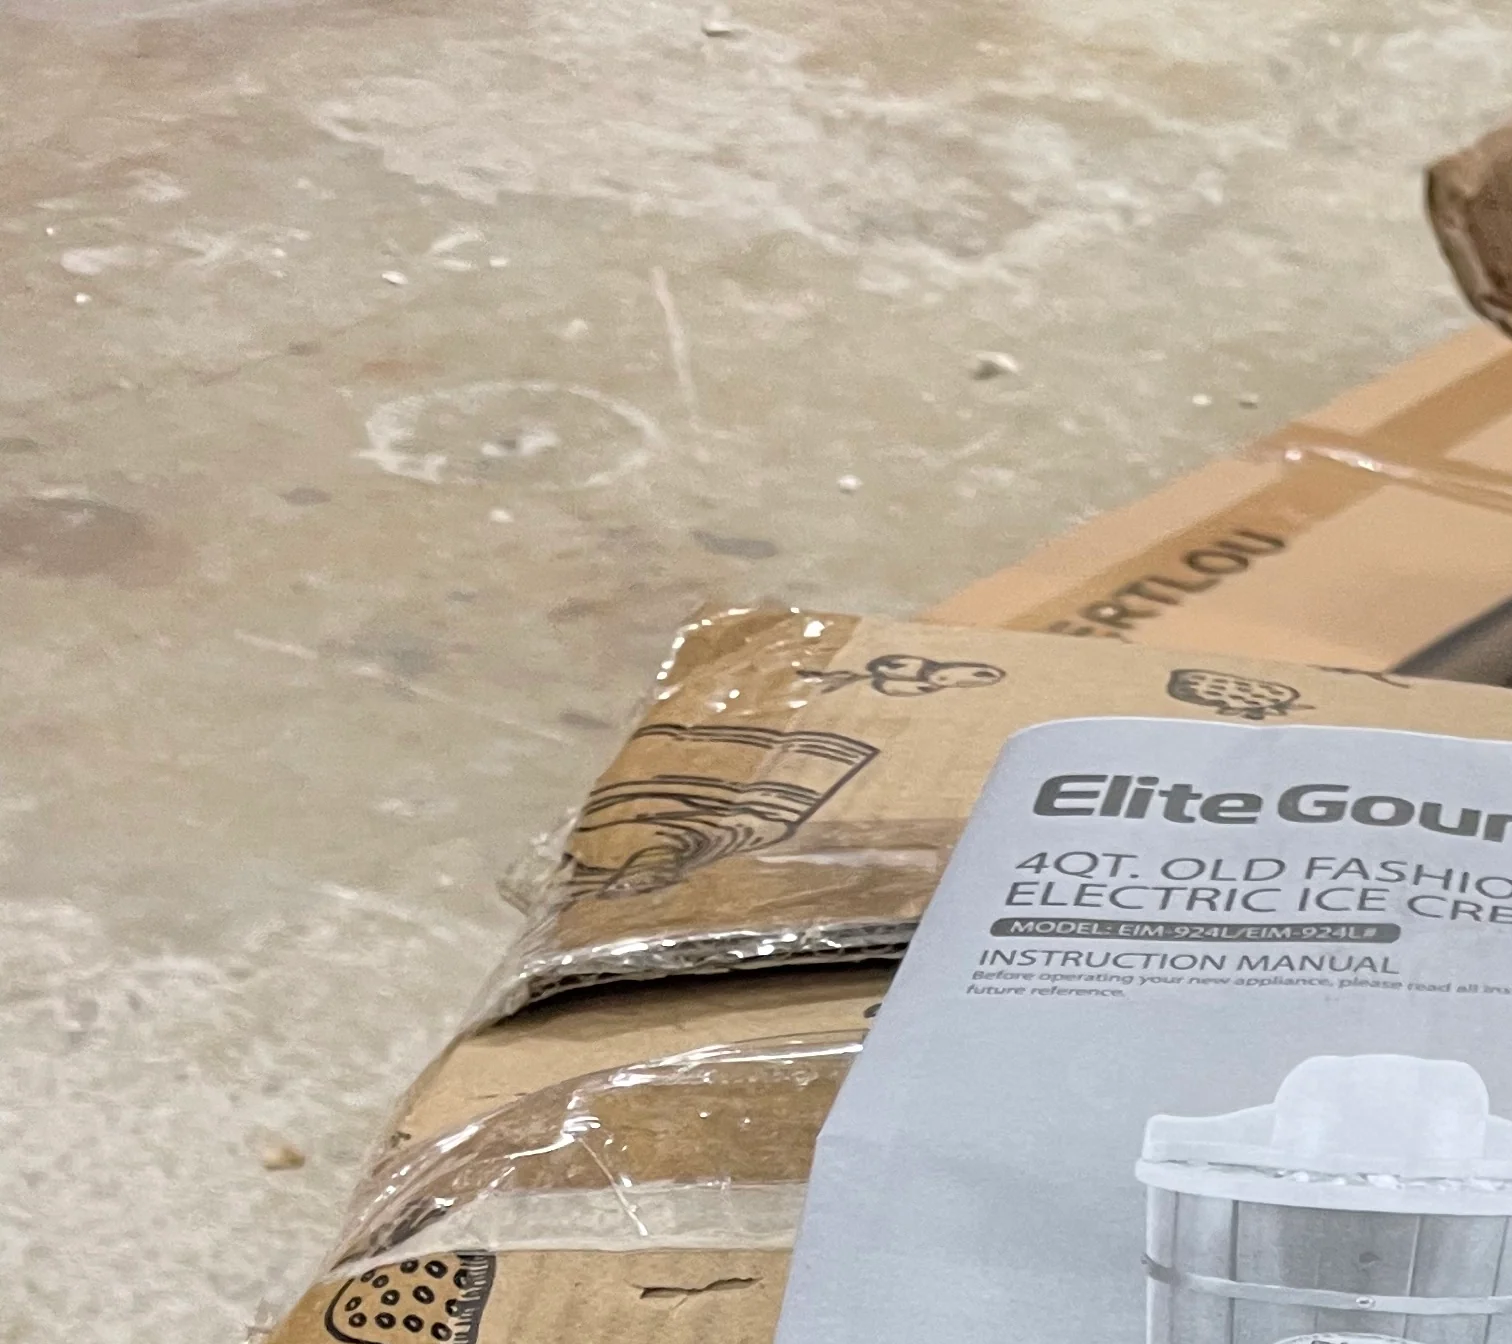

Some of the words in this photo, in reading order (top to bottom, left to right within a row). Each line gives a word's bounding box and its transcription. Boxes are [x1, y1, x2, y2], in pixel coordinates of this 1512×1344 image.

[1032, 774, 1265, 825] Elite
[1015, 851, 1139, 879] 4QT.
[1160, 857, 1286, 882] OLD
[1004, 881, 1282, 912] ELECTRIC
[1297, 888, 1391, 913] ICE
[1009, 919, 1112, 936] MODEL:
[979, 949, 1226, 972] INSTRUCTION
[1236, 954, 1400, 975] MANUAL
[966, 984, 1026, 995] future
[971, 970, 1035, 981] Before
[1038, 972, 1134, 985] operating
[1139, 975, 1185, 986] your
[1188, 976, 1231, 985] new
[1338, 977, 1403, 990] please
[1406, 981, 1451, 993] read
[1455, 983, 1479, 993] all
